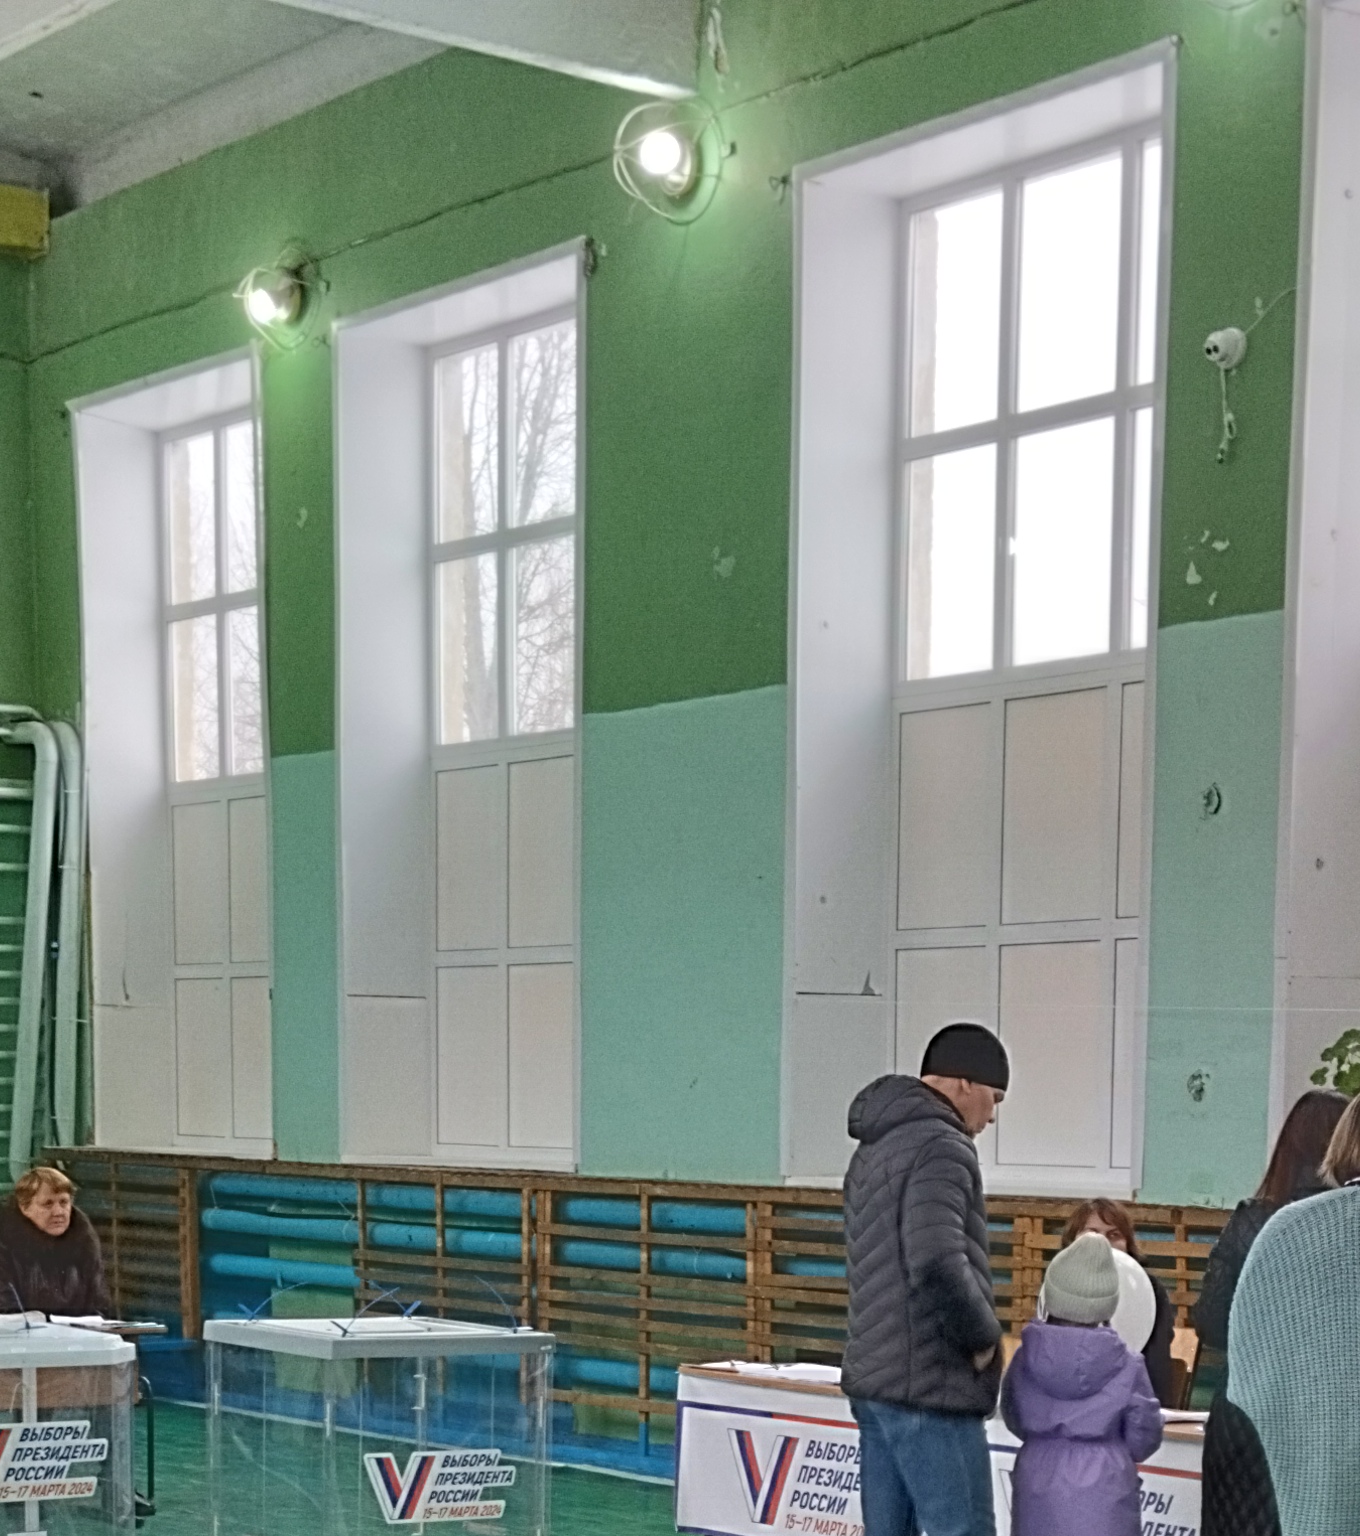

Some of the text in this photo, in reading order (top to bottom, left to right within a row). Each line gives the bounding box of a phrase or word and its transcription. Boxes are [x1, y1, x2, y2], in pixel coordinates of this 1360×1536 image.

[19, 1425, 87, 1443] ВЫБОРЫ
[11, 1444, 106, 1462] ПРЕЗИДЕНТА
[441, 1453, 498, 1468] ВЫБОРЫ
[4, 1465, 66, 1482] РОССИИ
[435, 1469, 514, 1486] ПРЕЗИДЕНТА
[796, 1465, 861, 1493] ПРЕЗИДЕ
[29, 1483, 66, 1497] МАРТА
[68, 1482, 93, 1496] 2024
[428, 1489, 480, 1504] РОССИИ
[448, 1506, 479, 1518] МАРТА
[480, 1504, 502, 1517] 2024
[789, 1490, 849, 1515] РОССИИ
